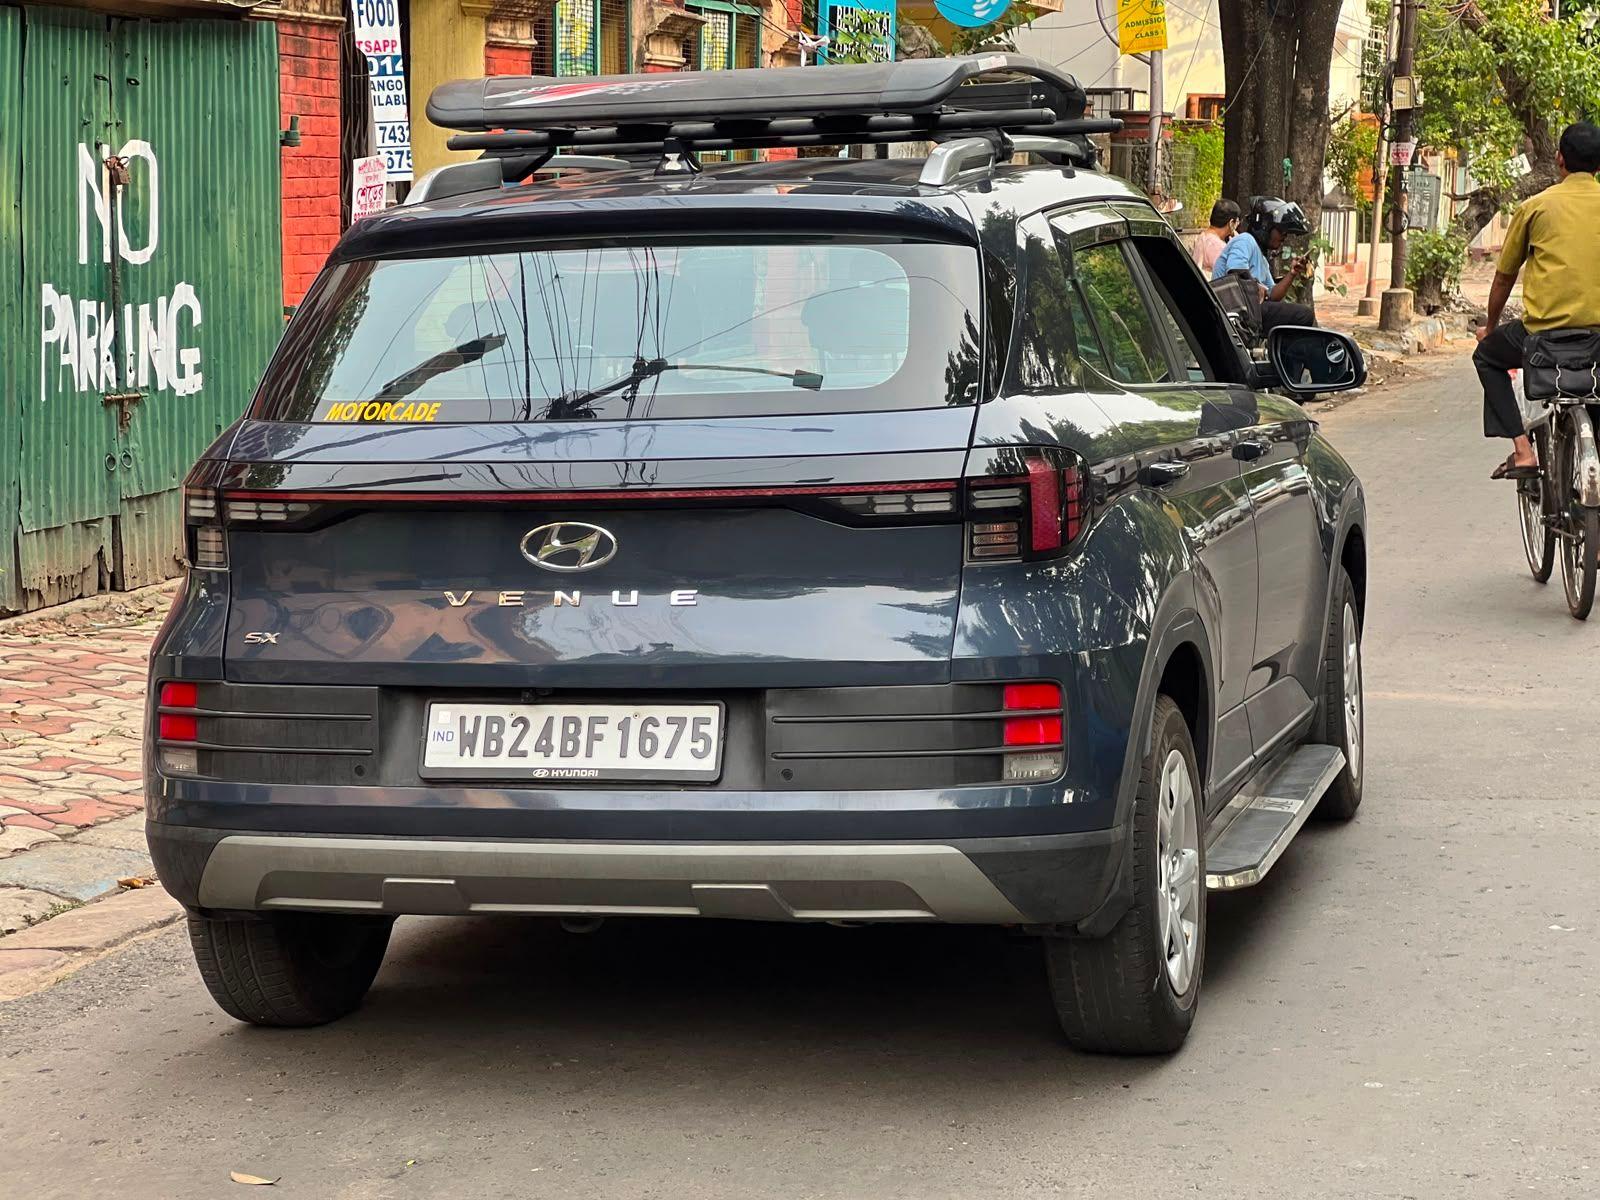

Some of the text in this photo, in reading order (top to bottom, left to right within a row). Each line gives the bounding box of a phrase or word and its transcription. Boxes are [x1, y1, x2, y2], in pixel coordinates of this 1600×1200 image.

[356, 0, 395, 28] FOOD
[1135, 30, 1159, 39] CLASS
[78, 139, 159, 265] NO
[40, 281, 203, 401] PARKING
[323, 402, 442, 422] MOTORCADE
[443, 589, 699, 608] VENUE
[243, 631, 281, 645] SX
[432, 730, 455, 742] IND
[458, 714, 713, 760] WB24BF1675
[550, 769, 599, 777] HYUNDAI
